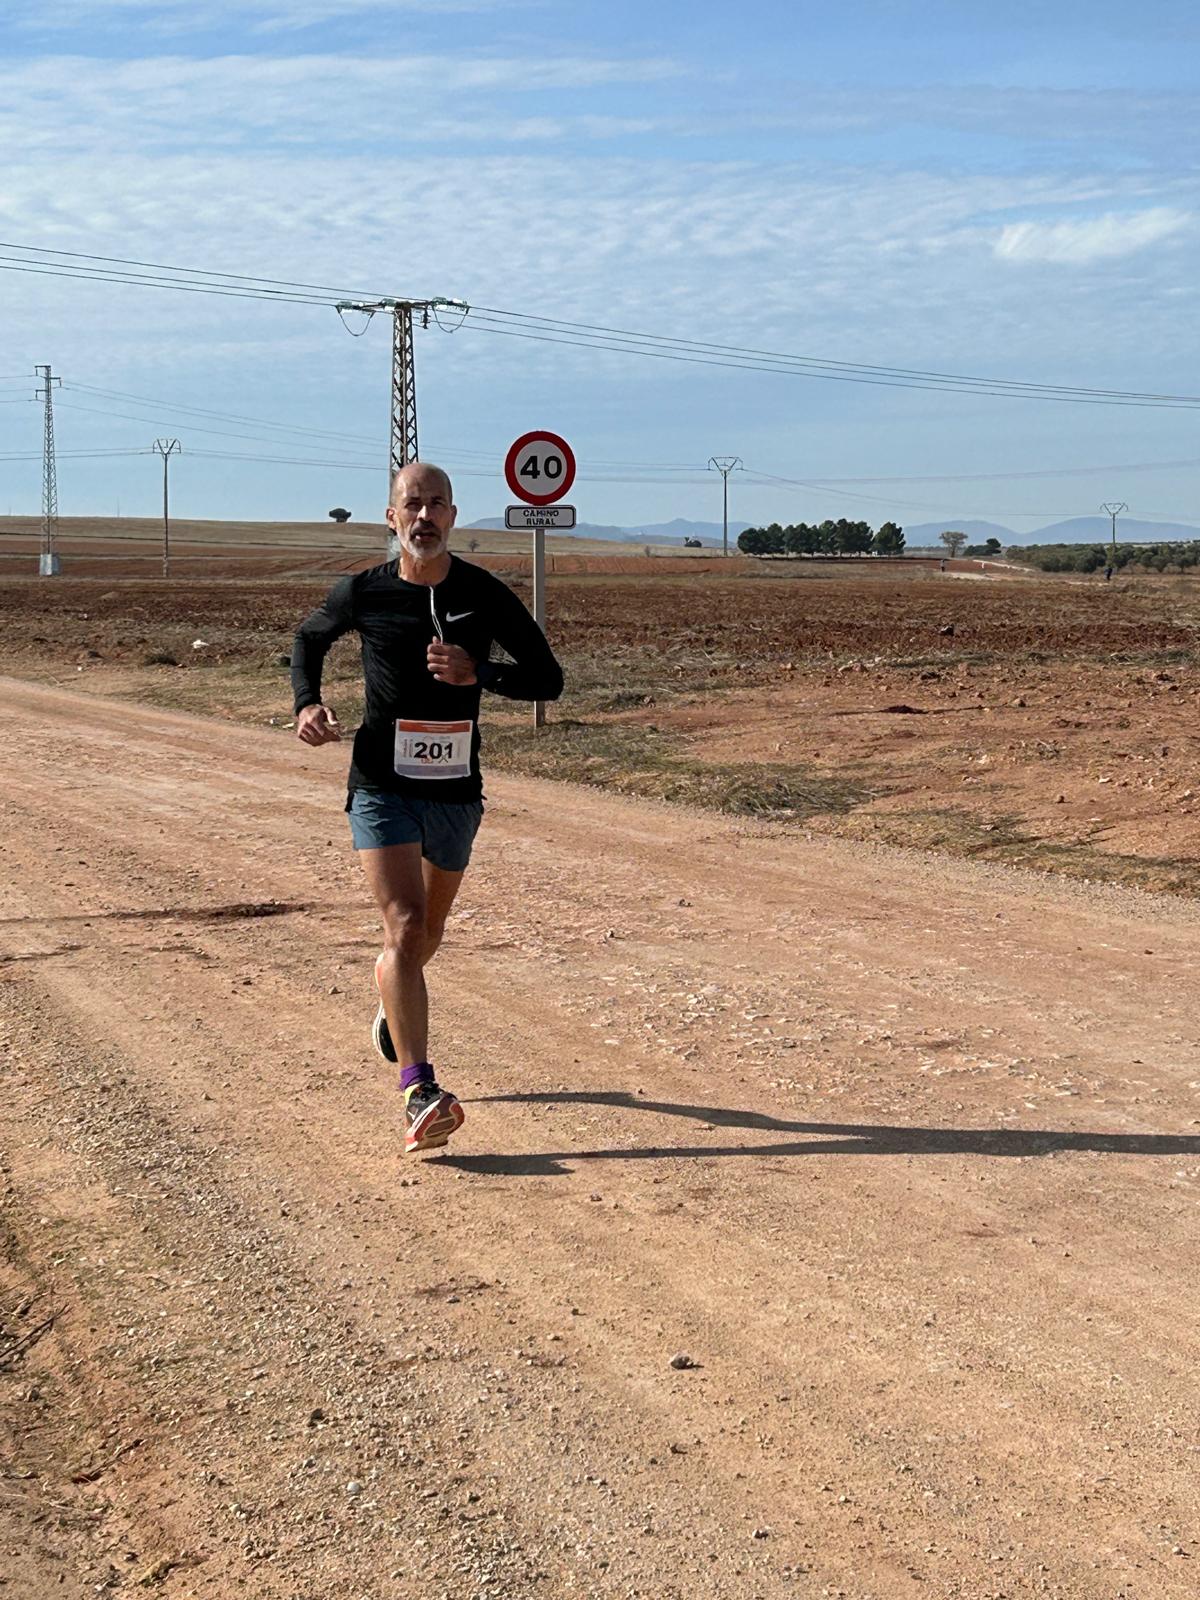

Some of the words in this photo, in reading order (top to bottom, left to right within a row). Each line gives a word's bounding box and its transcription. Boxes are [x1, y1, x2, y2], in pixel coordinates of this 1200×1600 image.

[520, 455, 562, 479] 40
[523, 509, 559, 517] CAMINO
[414, 742, 453, 759] 201
